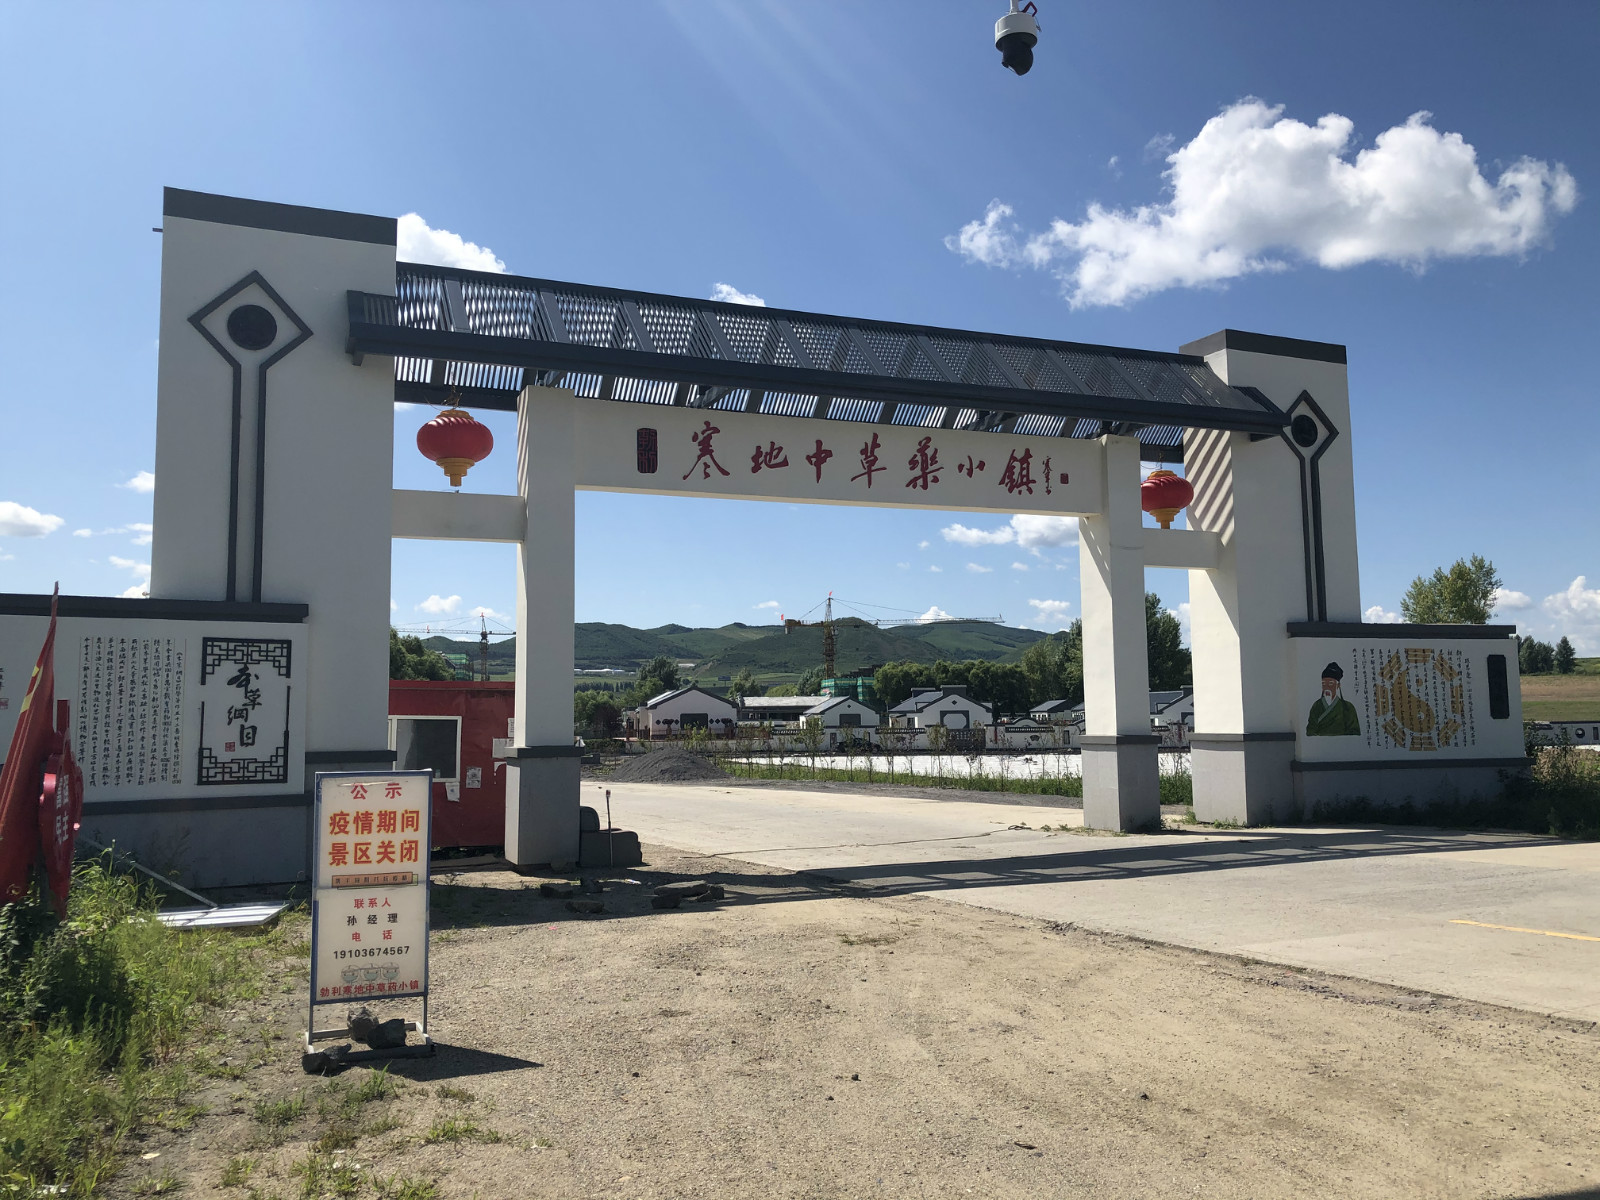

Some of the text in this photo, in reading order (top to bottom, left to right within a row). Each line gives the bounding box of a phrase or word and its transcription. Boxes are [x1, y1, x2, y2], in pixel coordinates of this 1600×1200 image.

[351, 783, 403, 800] 公示
[329, 809, 420, 836] 疫情期间
[328, 839, 420, 867] 景区关闭
[353, 897, 392, 910] 联系人
[346, 913, 398, 926] 孙经理
[351, 930, 393, 942] 电话
[333, 946, 410, 960] 19103674567
[320, 980, 419, 997] 勃利寒地中草药小镇
